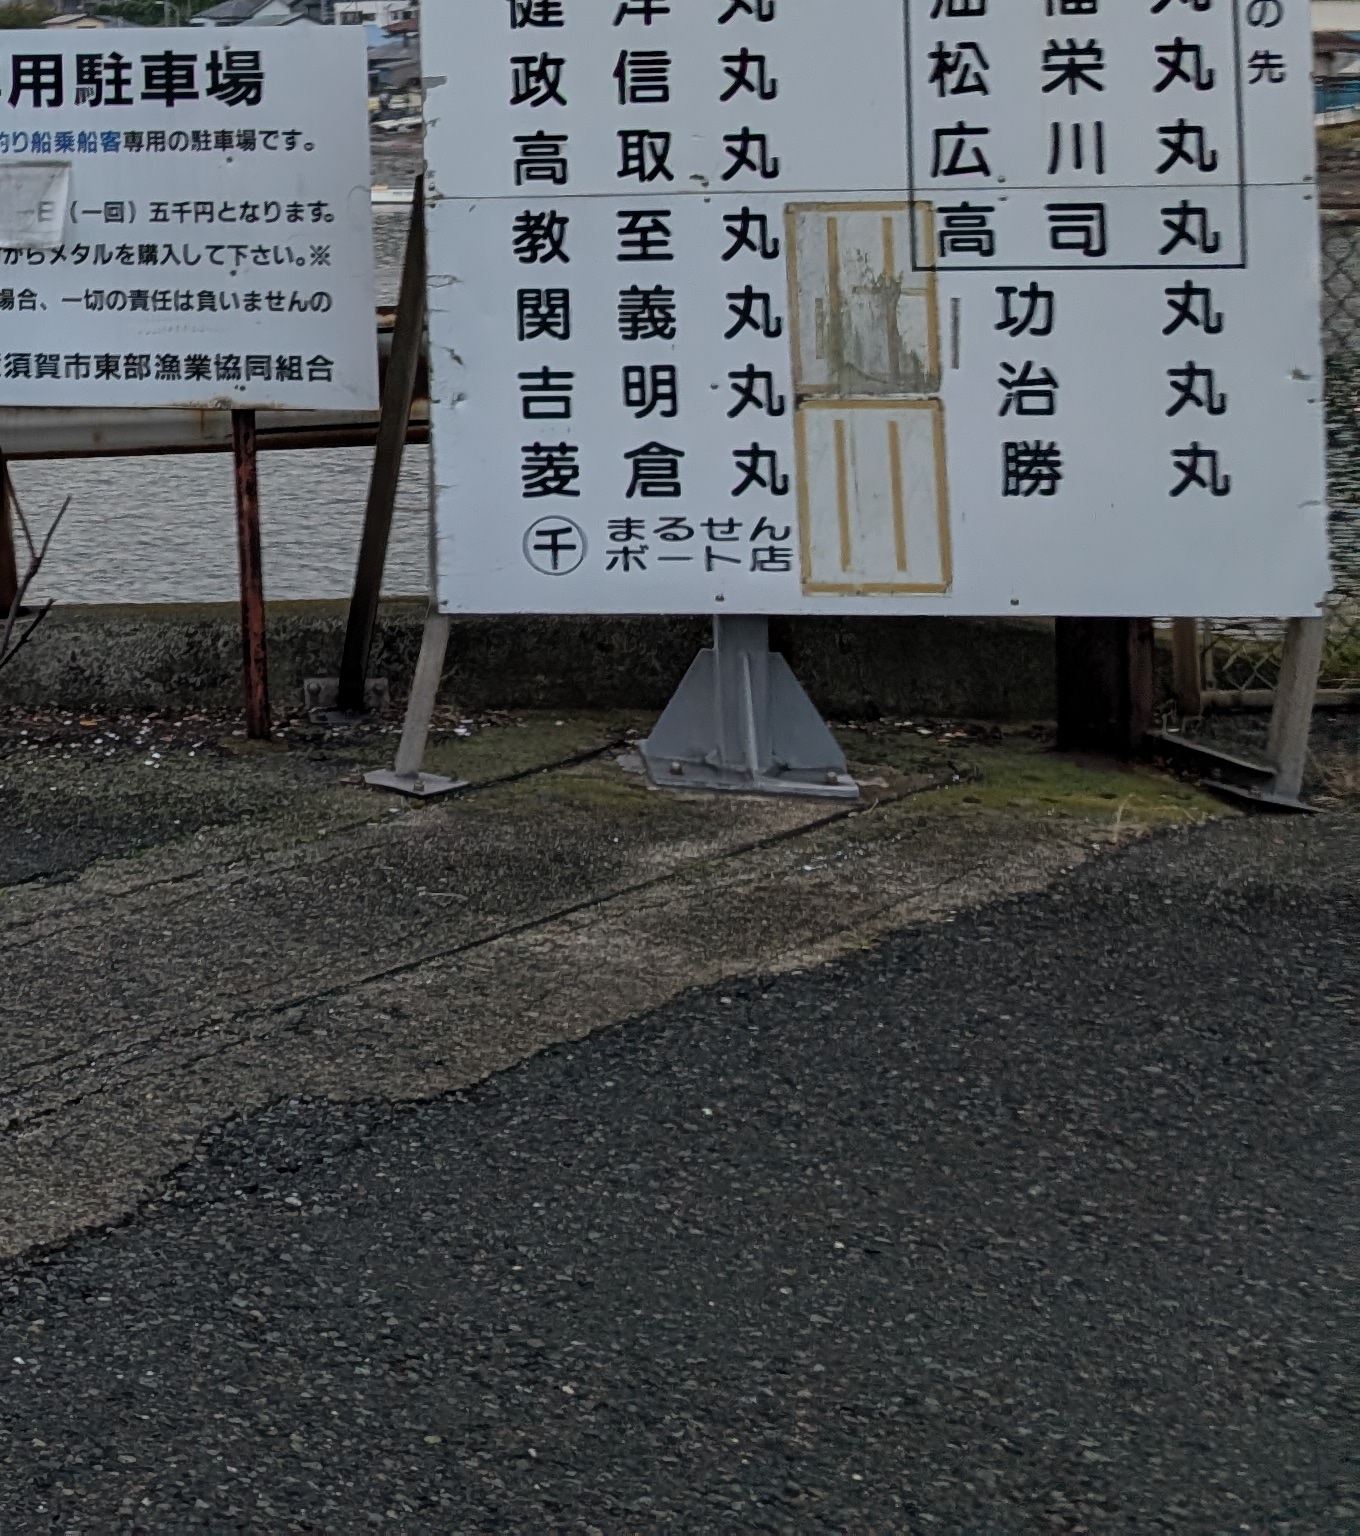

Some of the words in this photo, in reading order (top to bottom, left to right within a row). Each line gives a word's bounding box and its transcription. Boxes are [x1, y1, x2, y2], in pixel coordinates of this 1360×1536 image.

[509, 48, 779, 109] 政信丸
[927, 35, 1215, 96] 松栄丸
[514, 128, 781, 187] 高取丸
[931, 119, 1217, 179] 広川丸
[511, 207, 780, 265] 教至丸
[936, 198, 1221, 258] 高司丸
[516, 284, 783, 343] 関義丸
[518, 363, 785, 421] 吉明丸
[520, 440, 790, 500] 菱倉丸
[605, 545, 793, 572] ボート店
[607, 517, 790, 542] まるせん
